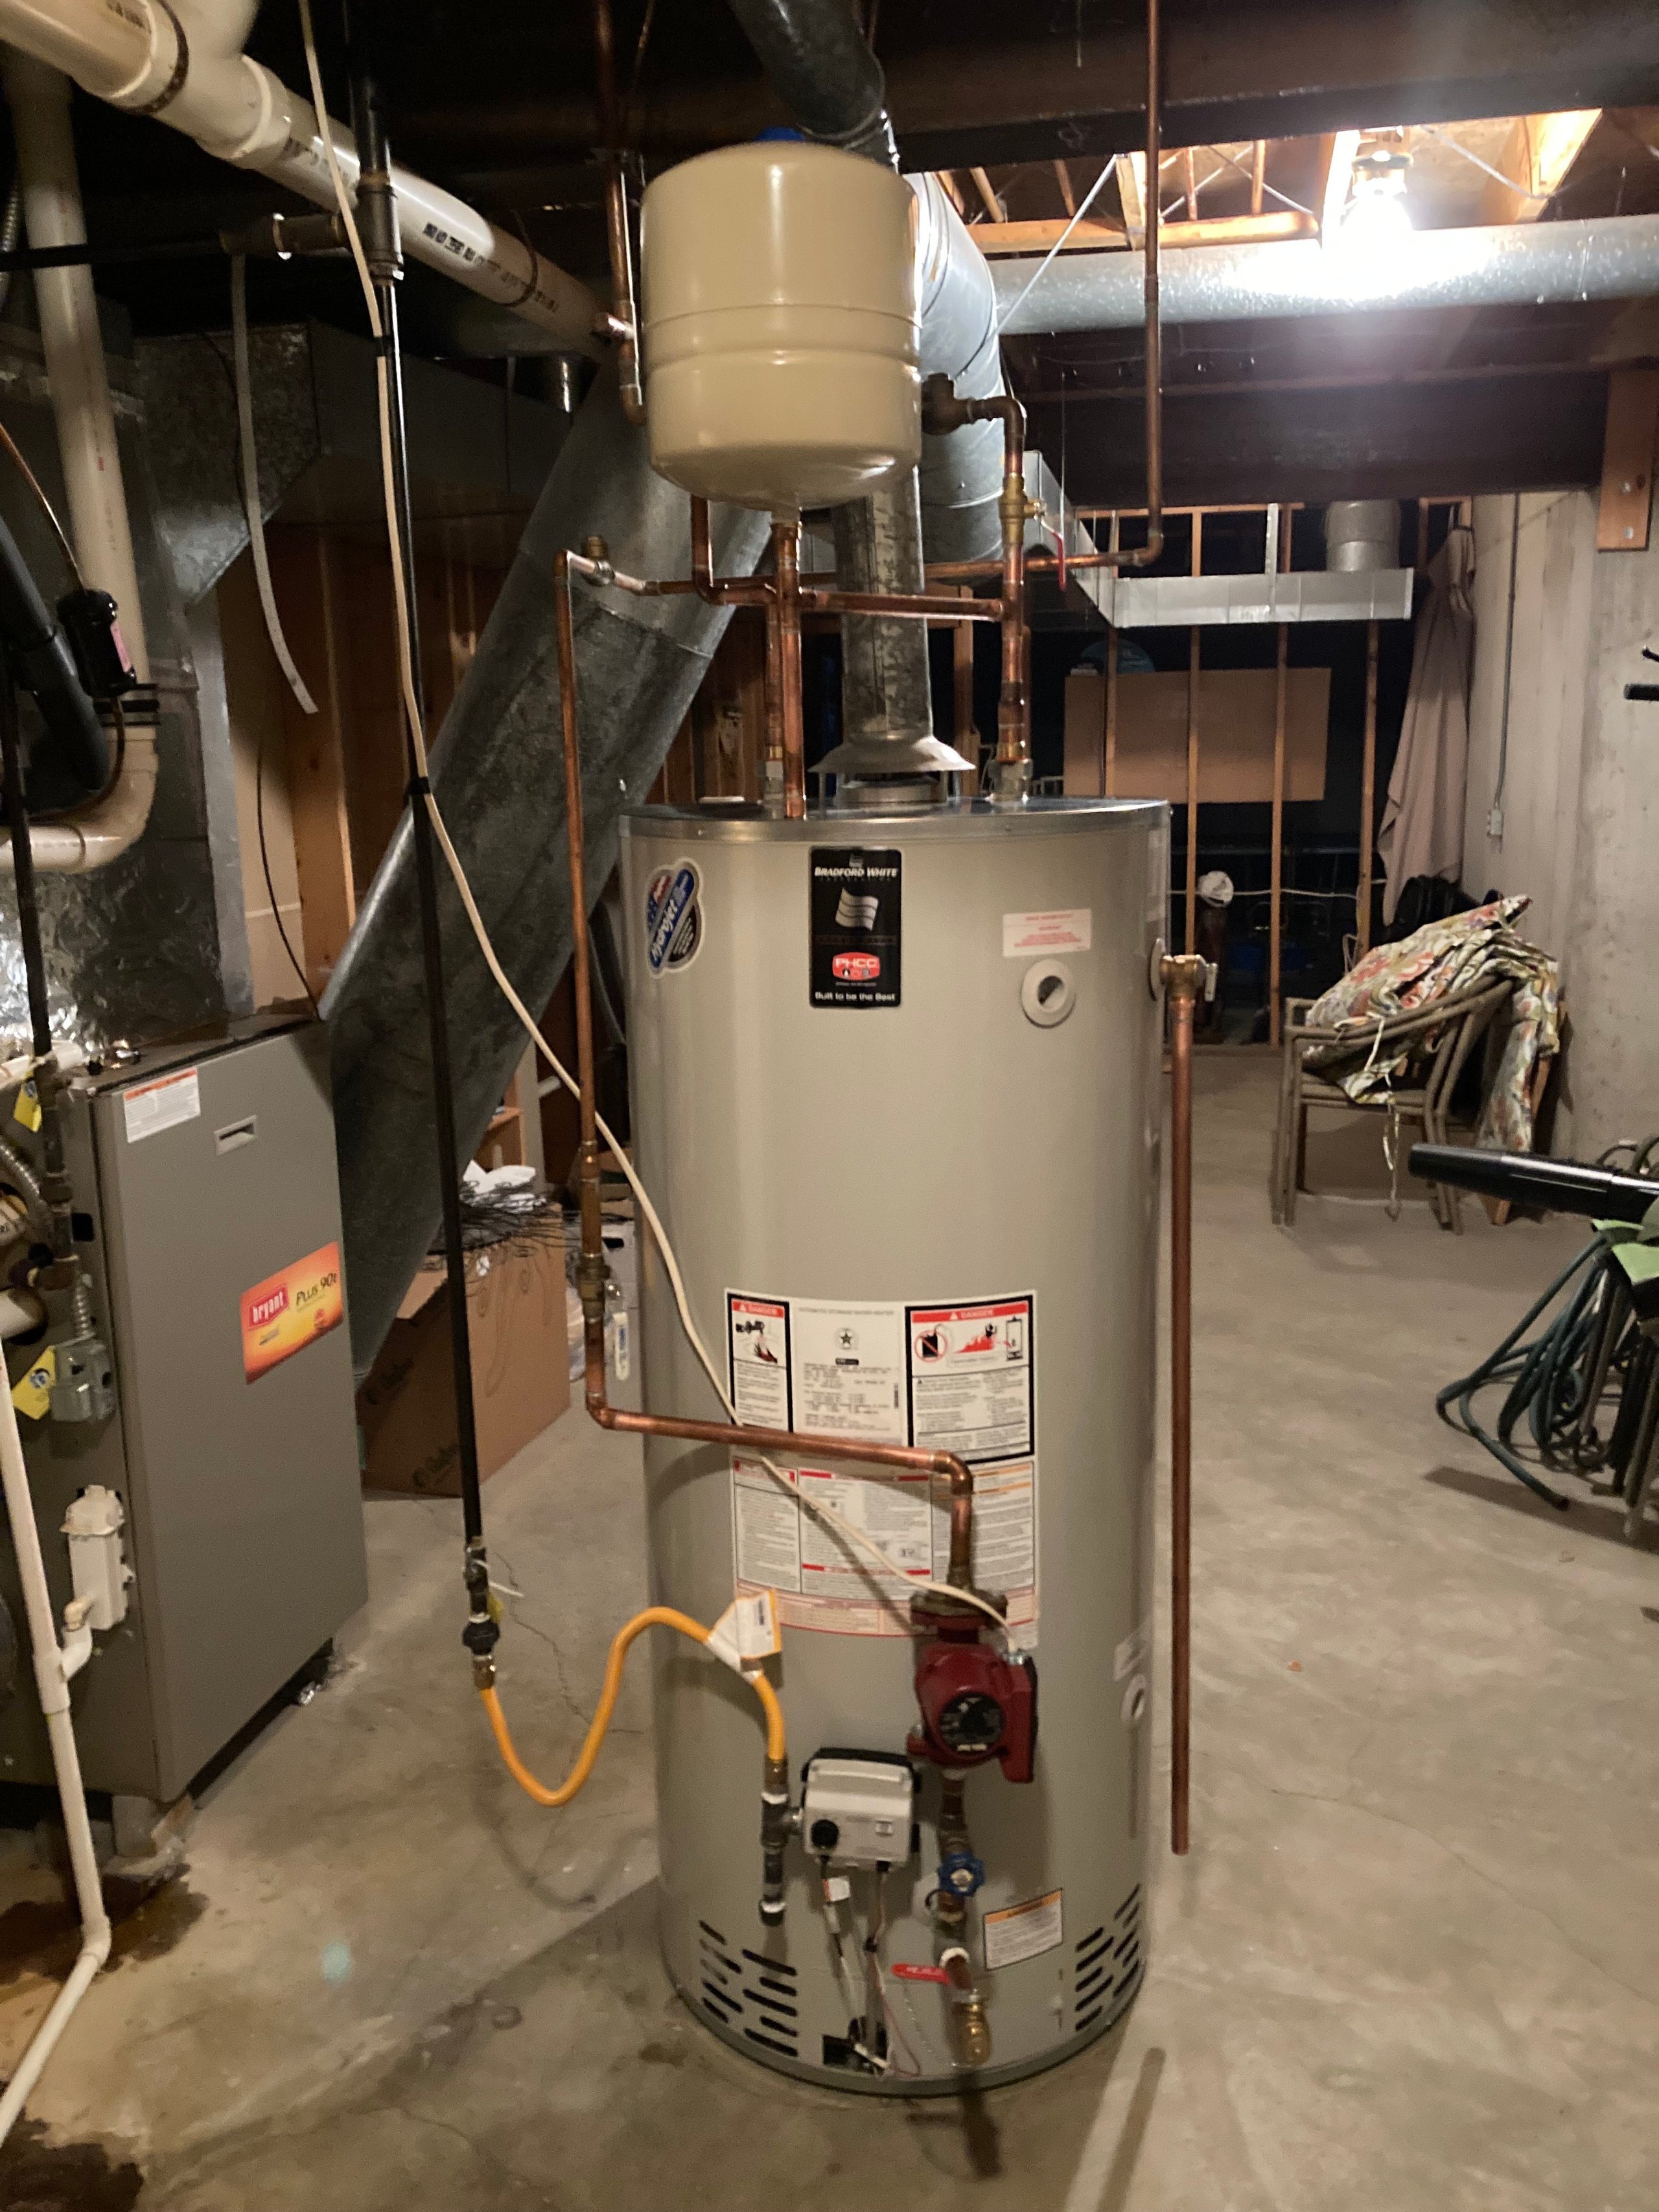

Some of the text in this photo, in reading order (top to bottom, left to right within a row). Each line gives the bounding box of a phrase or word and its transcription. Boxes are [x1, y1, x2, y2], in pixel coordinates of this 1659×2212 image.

[815, 867, 898, 878] BRADFORD WHITE
[835, 958, 877, 968] PHCC
[815, 991, 896, 1001] Built to be the Best
[252, 1290, 284, 1323] bryant
